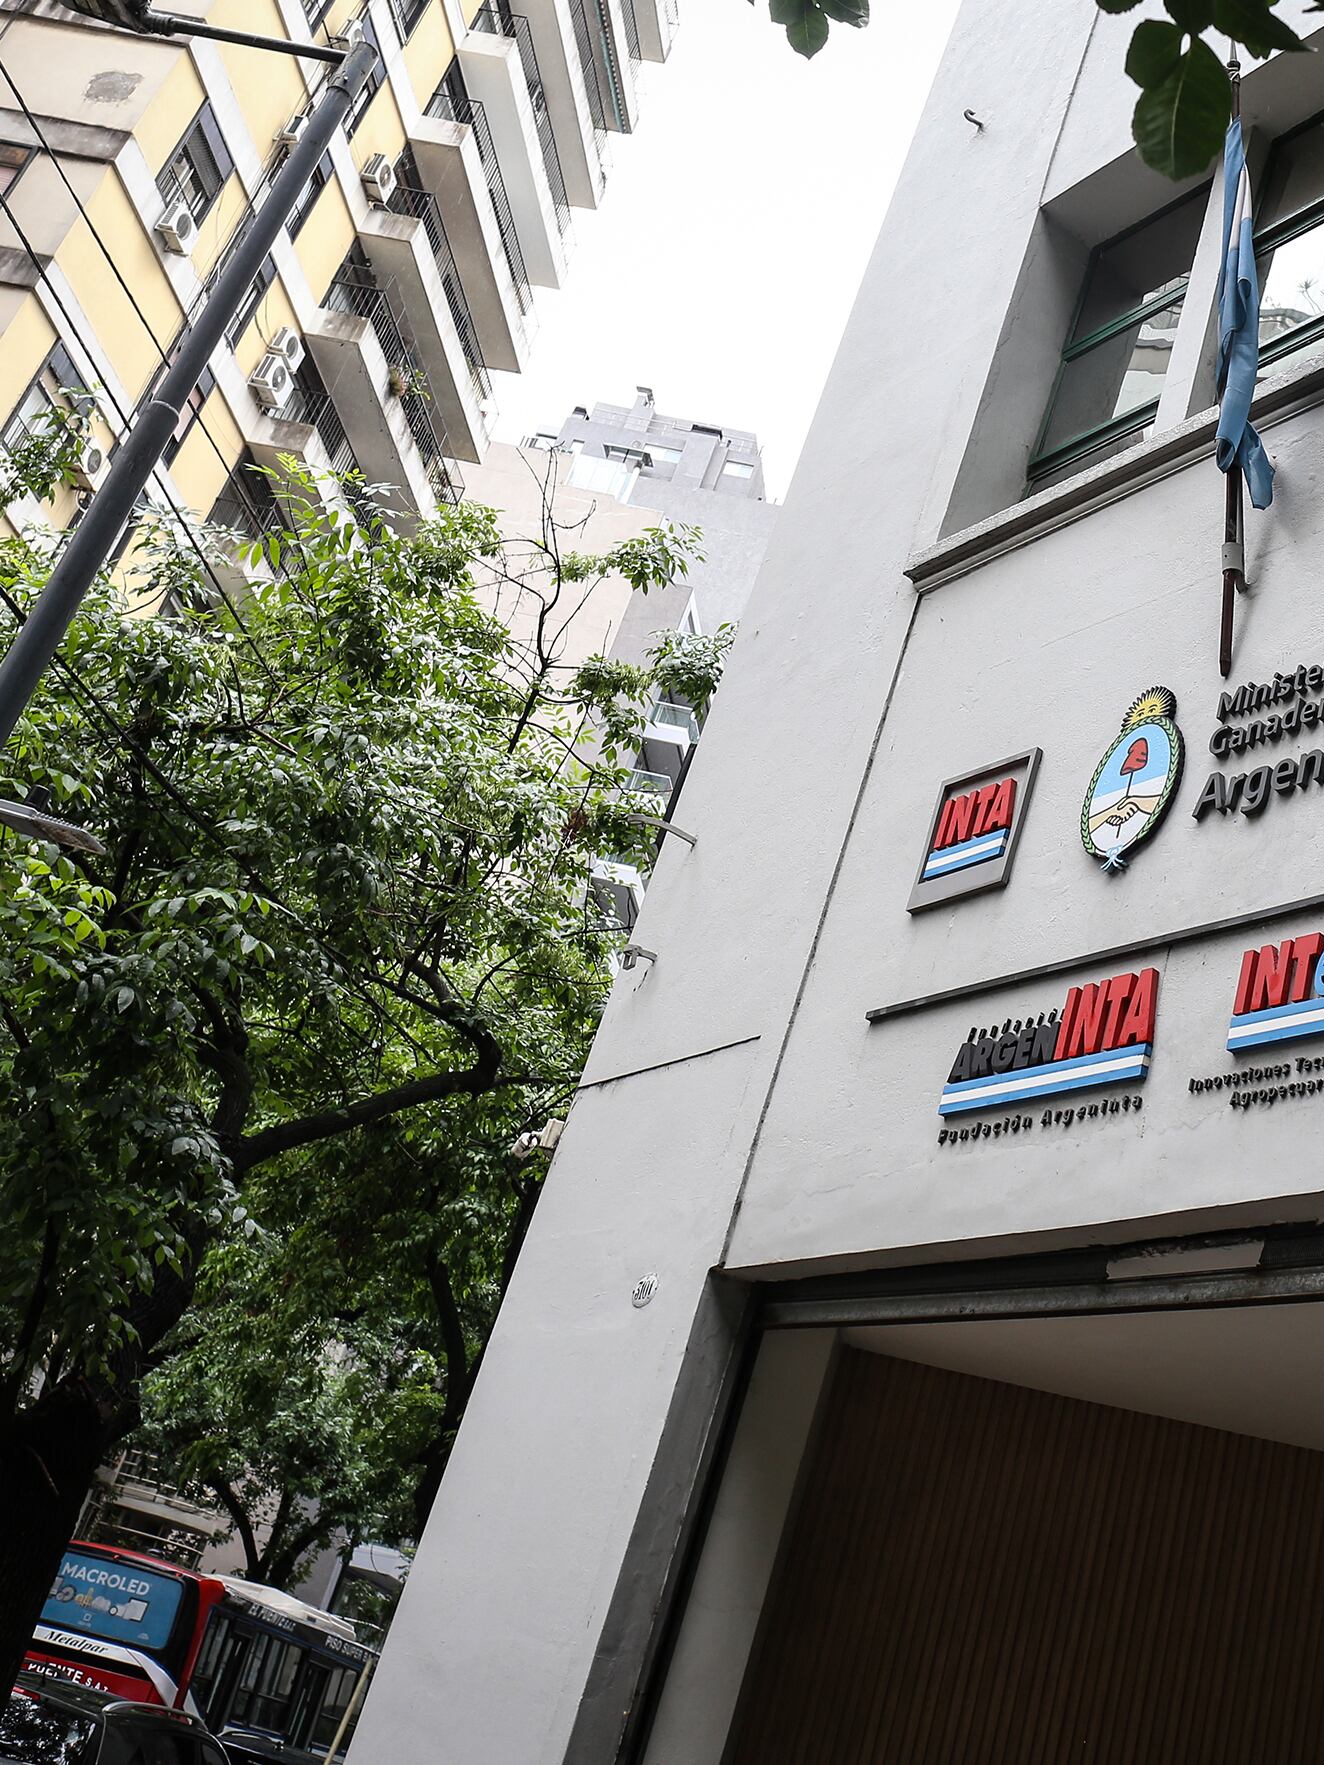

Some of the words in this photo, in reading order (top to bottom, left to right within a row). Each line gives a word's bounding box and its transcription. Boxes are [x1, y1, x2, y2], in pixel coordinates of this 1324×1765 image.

[934, 777, 1017, 850] INTA
[947, 967, 1159, 1083] ARGENINTA
[1188, 1063, 1291, 1093] Innovaciones
[1040, 1095, 1143, 1127] Argeninta
[62, 1562, 150, 1596] MACROLED
[45, 1630, 108, 1654] Metalpar
